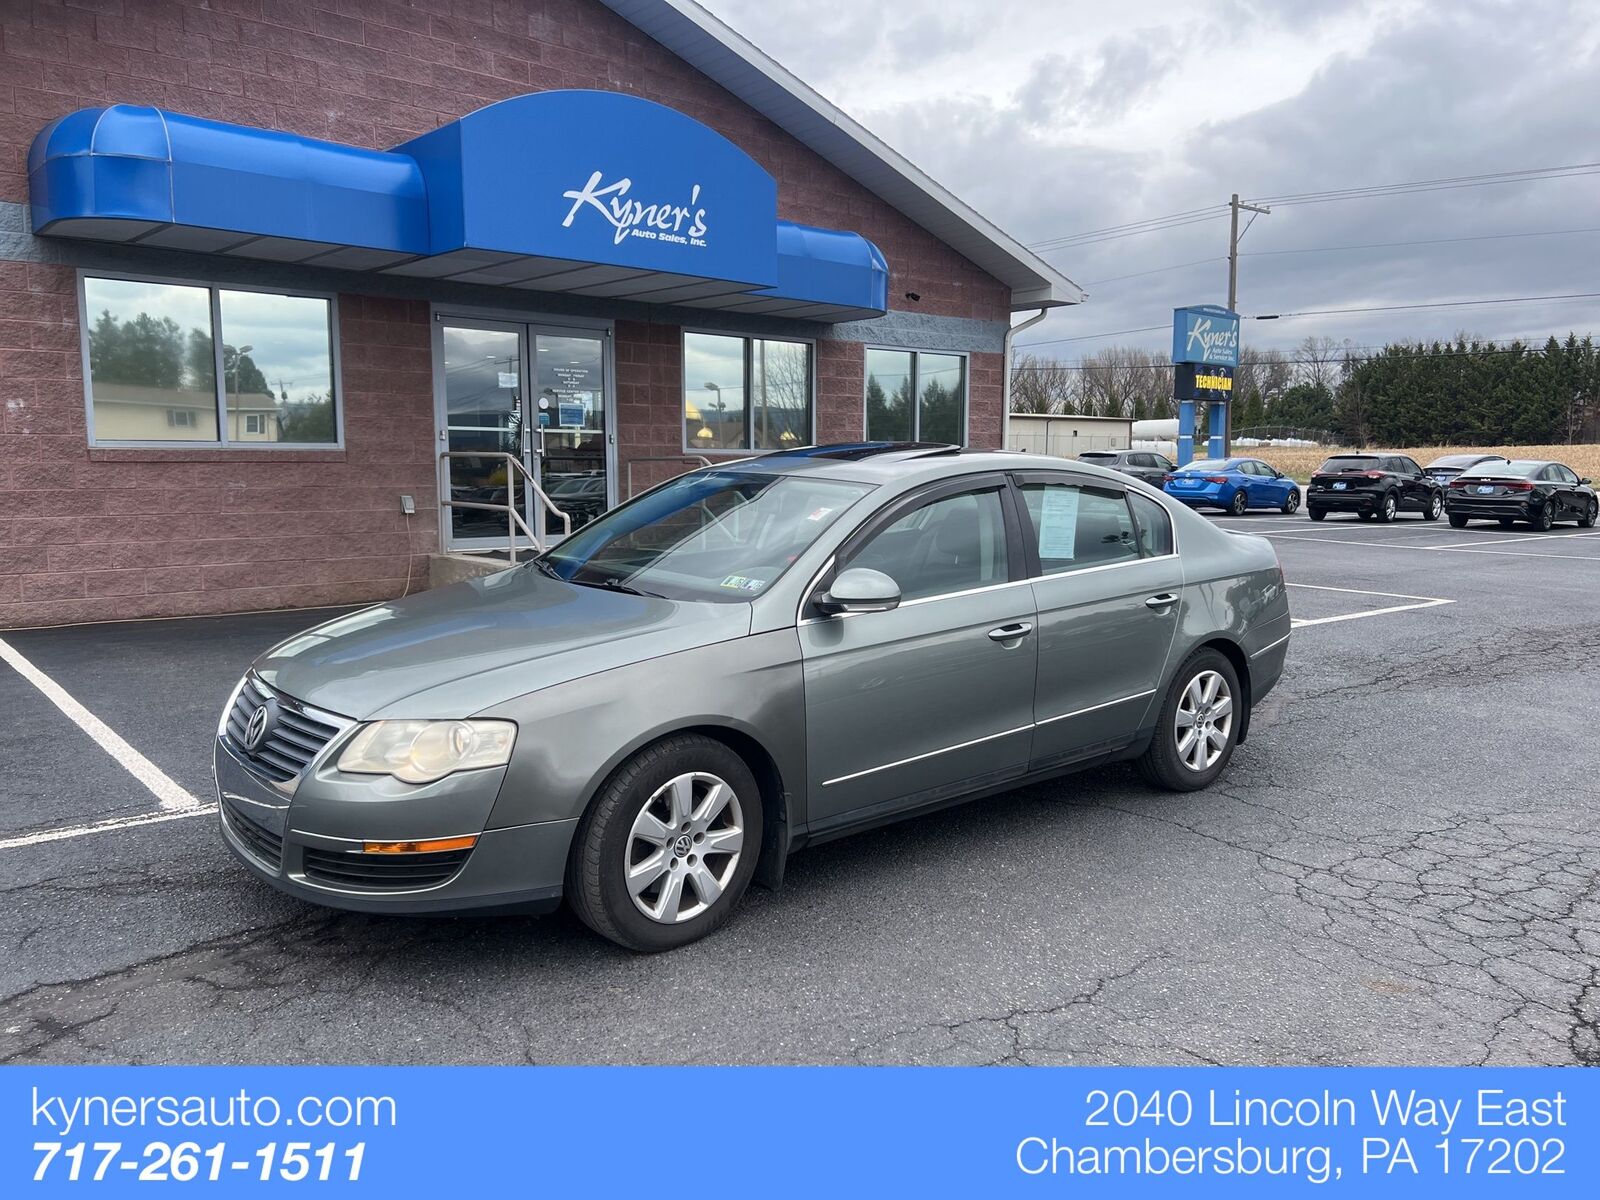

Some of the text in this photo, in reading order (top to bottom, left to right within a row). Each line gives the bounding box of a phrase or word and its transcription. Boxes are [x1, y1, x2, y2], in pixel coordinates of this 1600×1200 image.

[562, 170, 707, 245] Kyner's
[631, 229, 707, 247] Auto Sales, Inc.
[1187, 317, 1238, 361] Kyner's
[1195, 374, 1232, 391] TECHNICIAN
